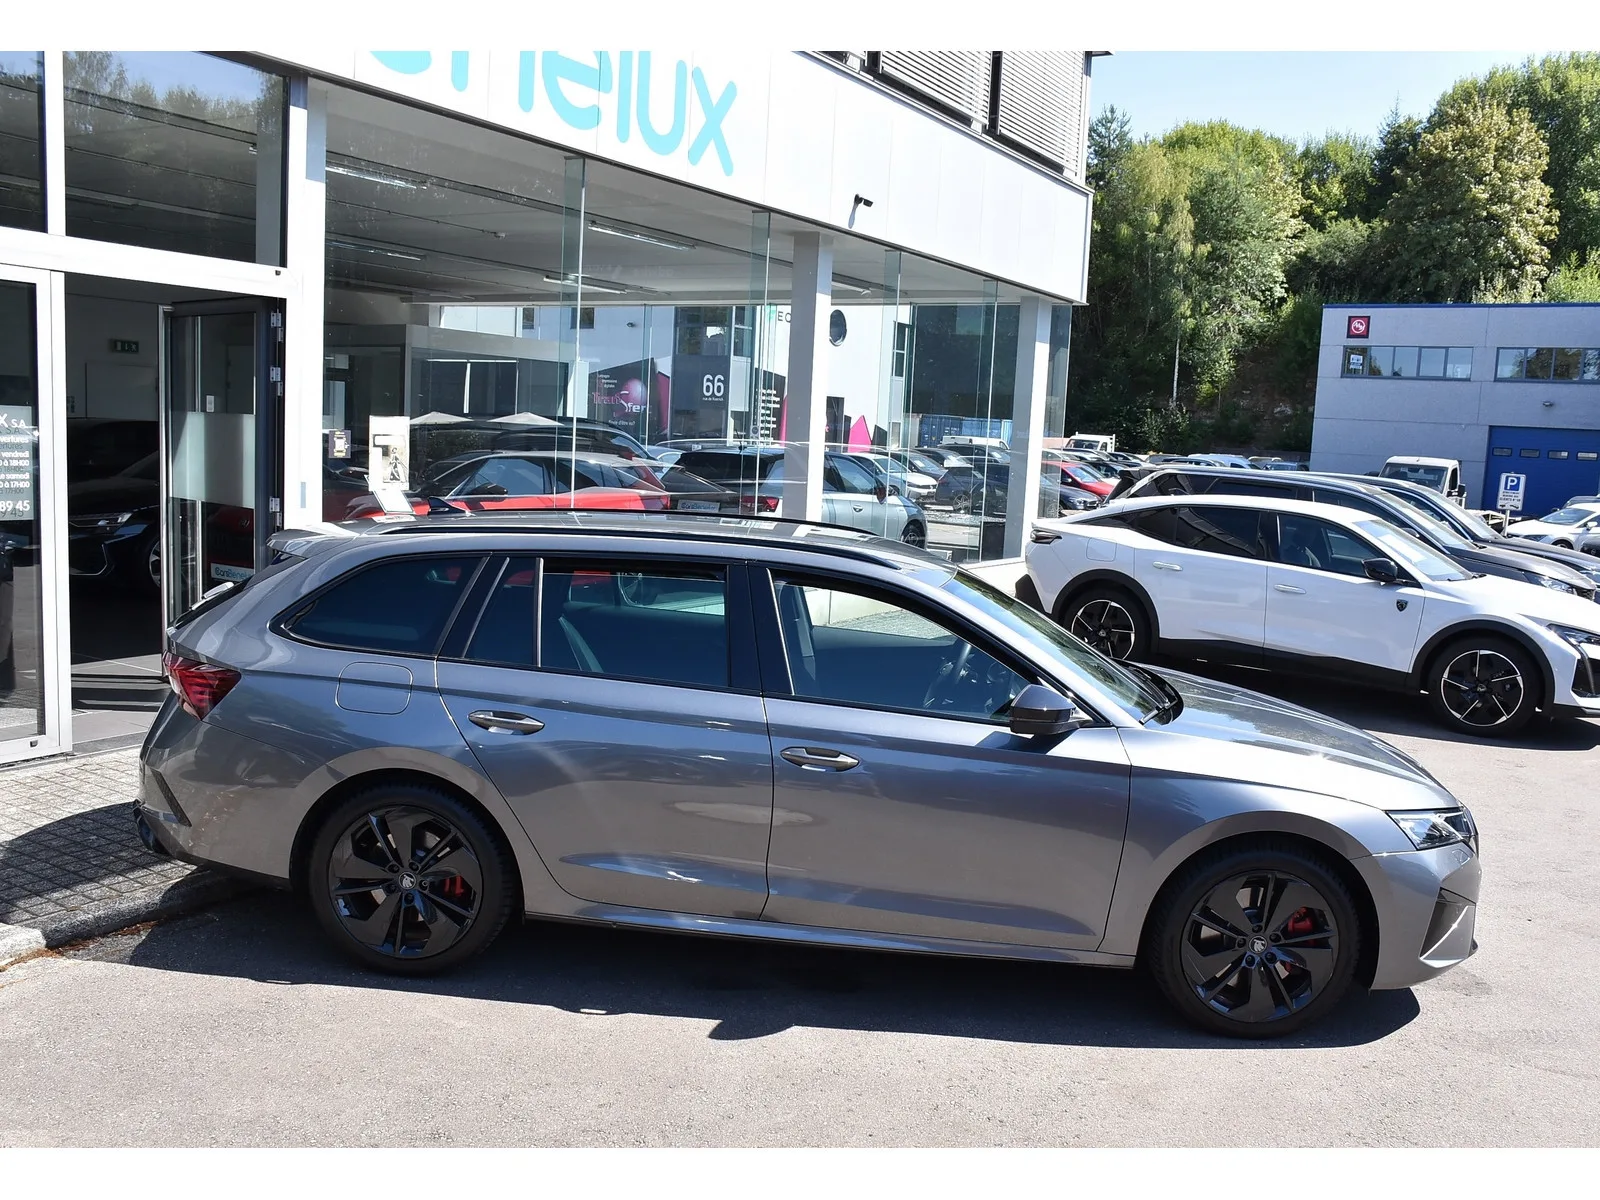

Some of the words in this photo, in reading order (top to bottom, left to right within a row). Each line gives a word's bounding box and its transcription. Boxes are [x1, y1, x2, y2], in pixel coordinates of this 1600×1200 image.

[703, 374, 725, 397] 66
[1507, 477, 1518, 490] P
[16, 500, 31, 512] 45
